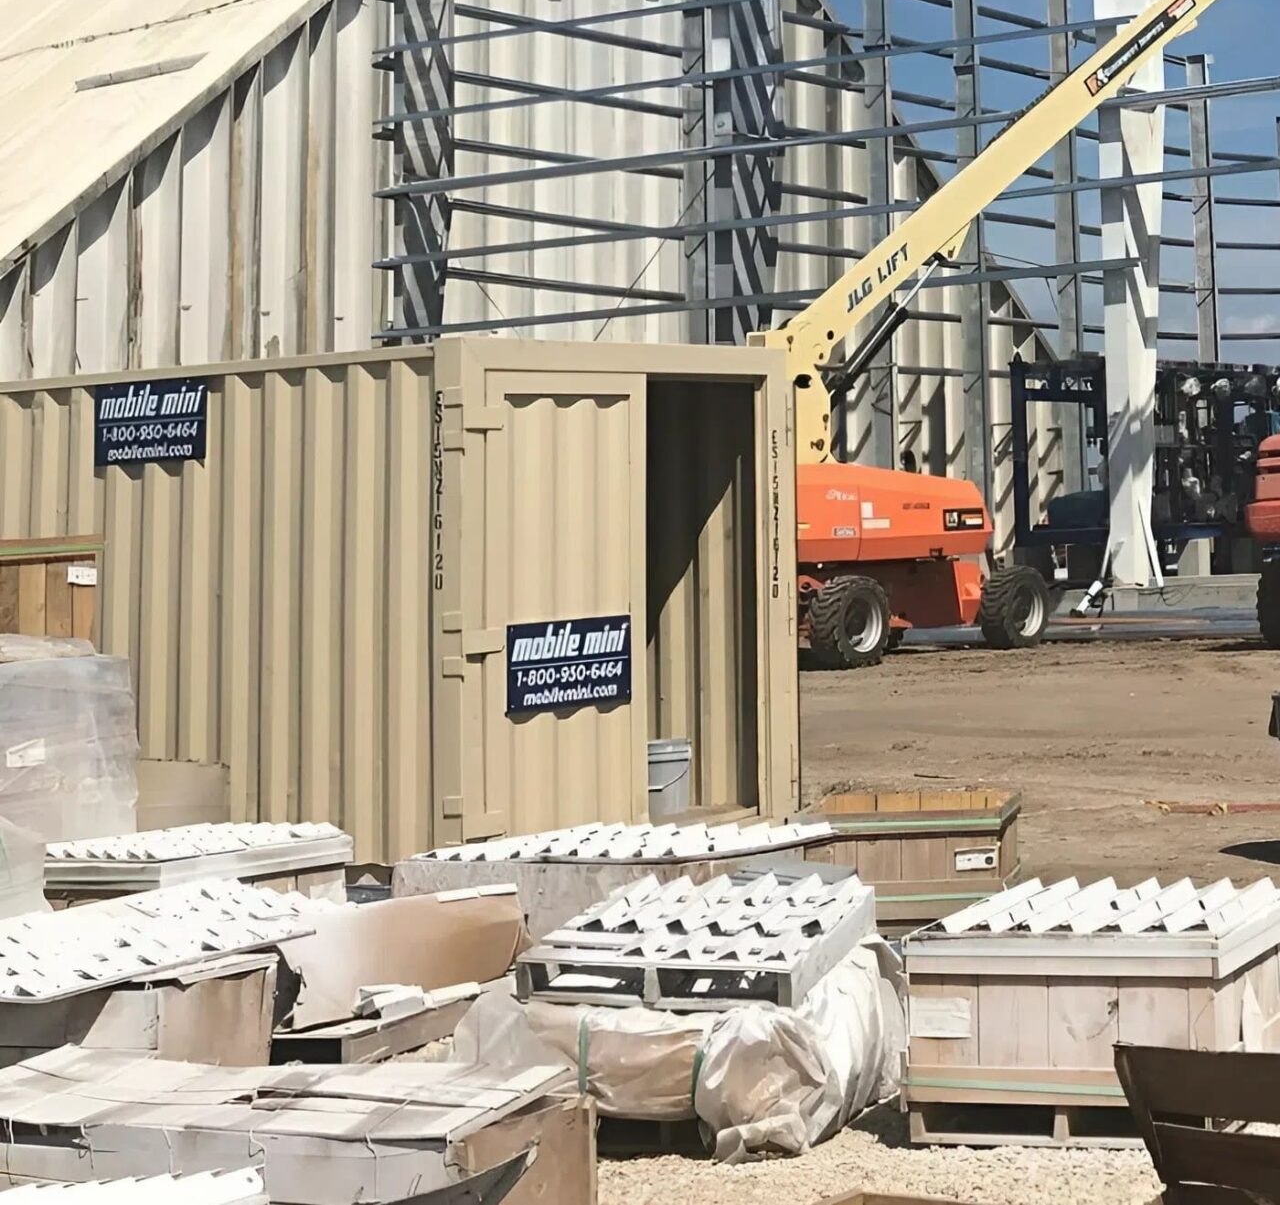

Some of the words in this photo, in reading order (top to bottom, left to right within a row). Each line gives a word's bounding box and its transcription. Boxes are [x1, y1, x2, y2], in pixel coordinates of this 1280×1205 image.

[847, 276, 873, 313] JLG
[877, 241, 908, 284] LIFT
[99, 384, 159, 420] mobile
[160, 385, 206, 415] mini
[511, 622, 581, 663] mobile
[582, 622, 630, 656] mini
[517, 661, 623, 688] 1-800-950-6464
[523, 682, 618, 707] mobilemini.com
